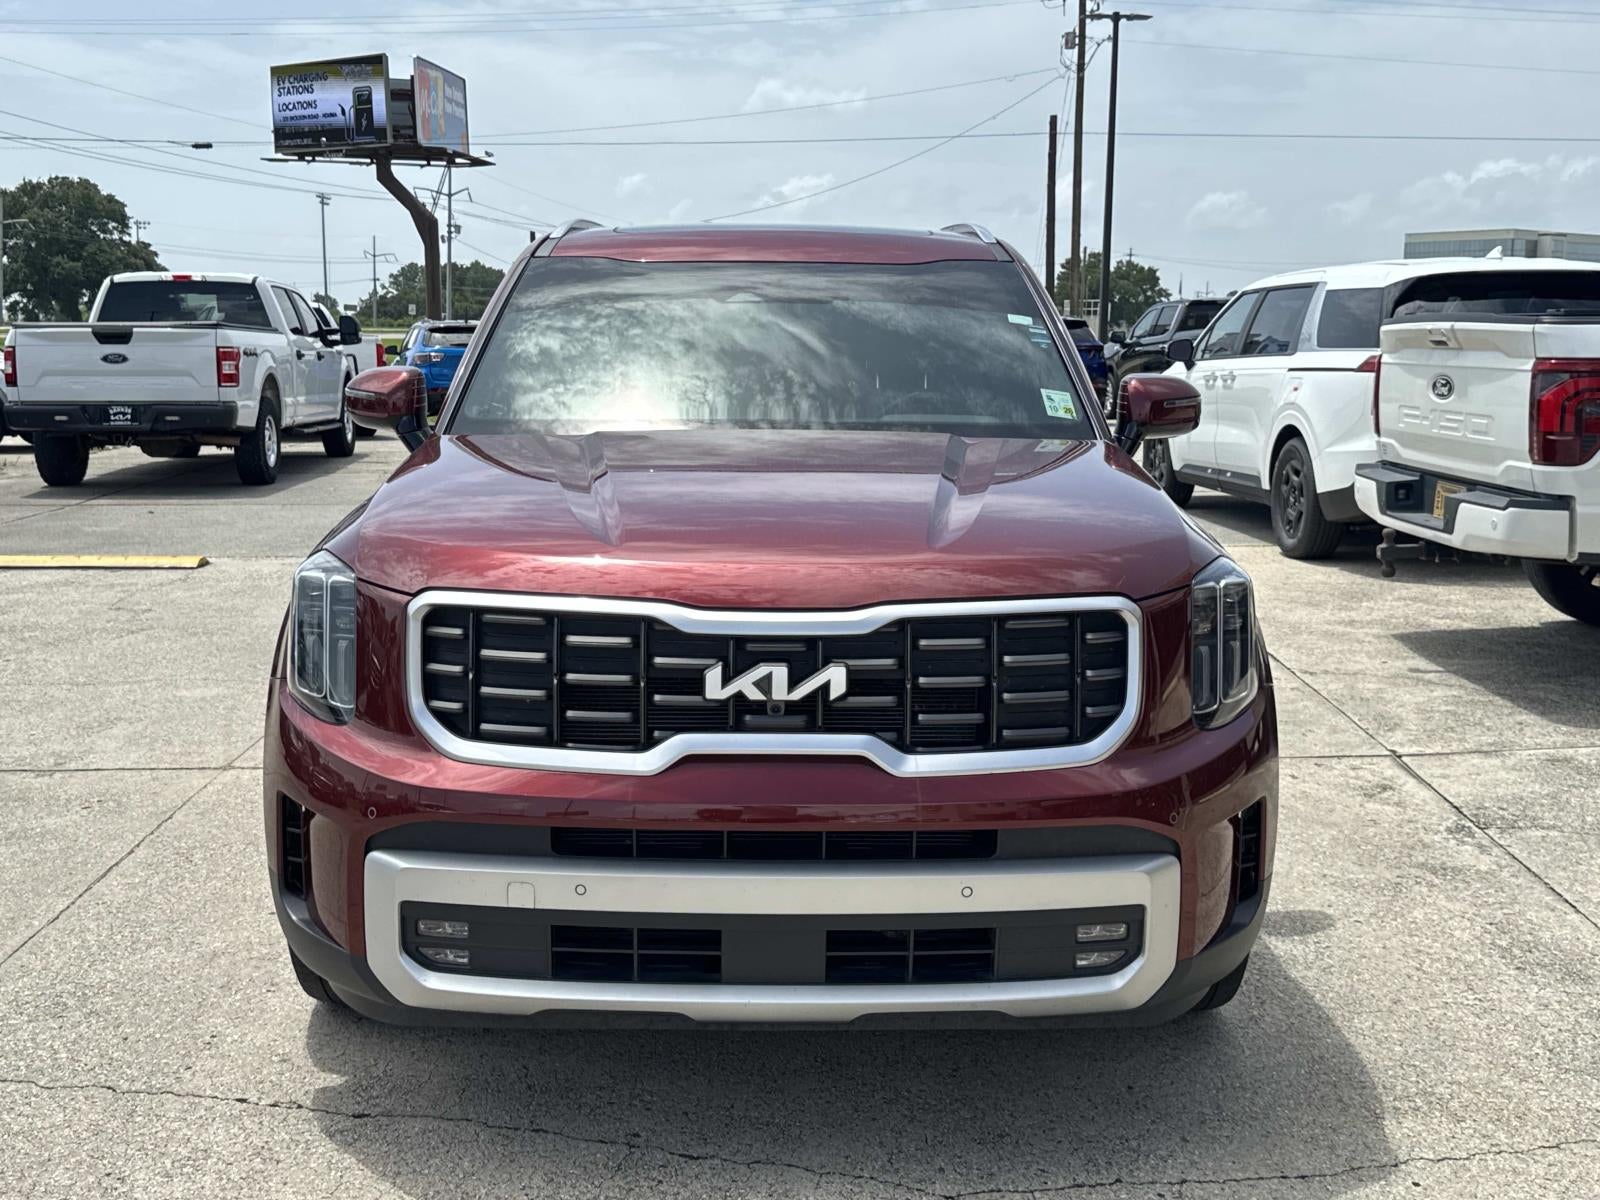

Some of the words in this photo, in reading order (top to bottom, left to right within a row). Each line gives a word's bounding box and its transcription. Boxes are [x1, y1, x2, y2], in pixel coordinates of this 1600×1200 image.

[277, 75, 286, 86] EV
[288, 72, 329, 85] CHARGING
[277, 84, 315, 97] STATIONS
[278, 99, 318, 113] LOCATIONS
[703, 661, 847, 701] KIA
